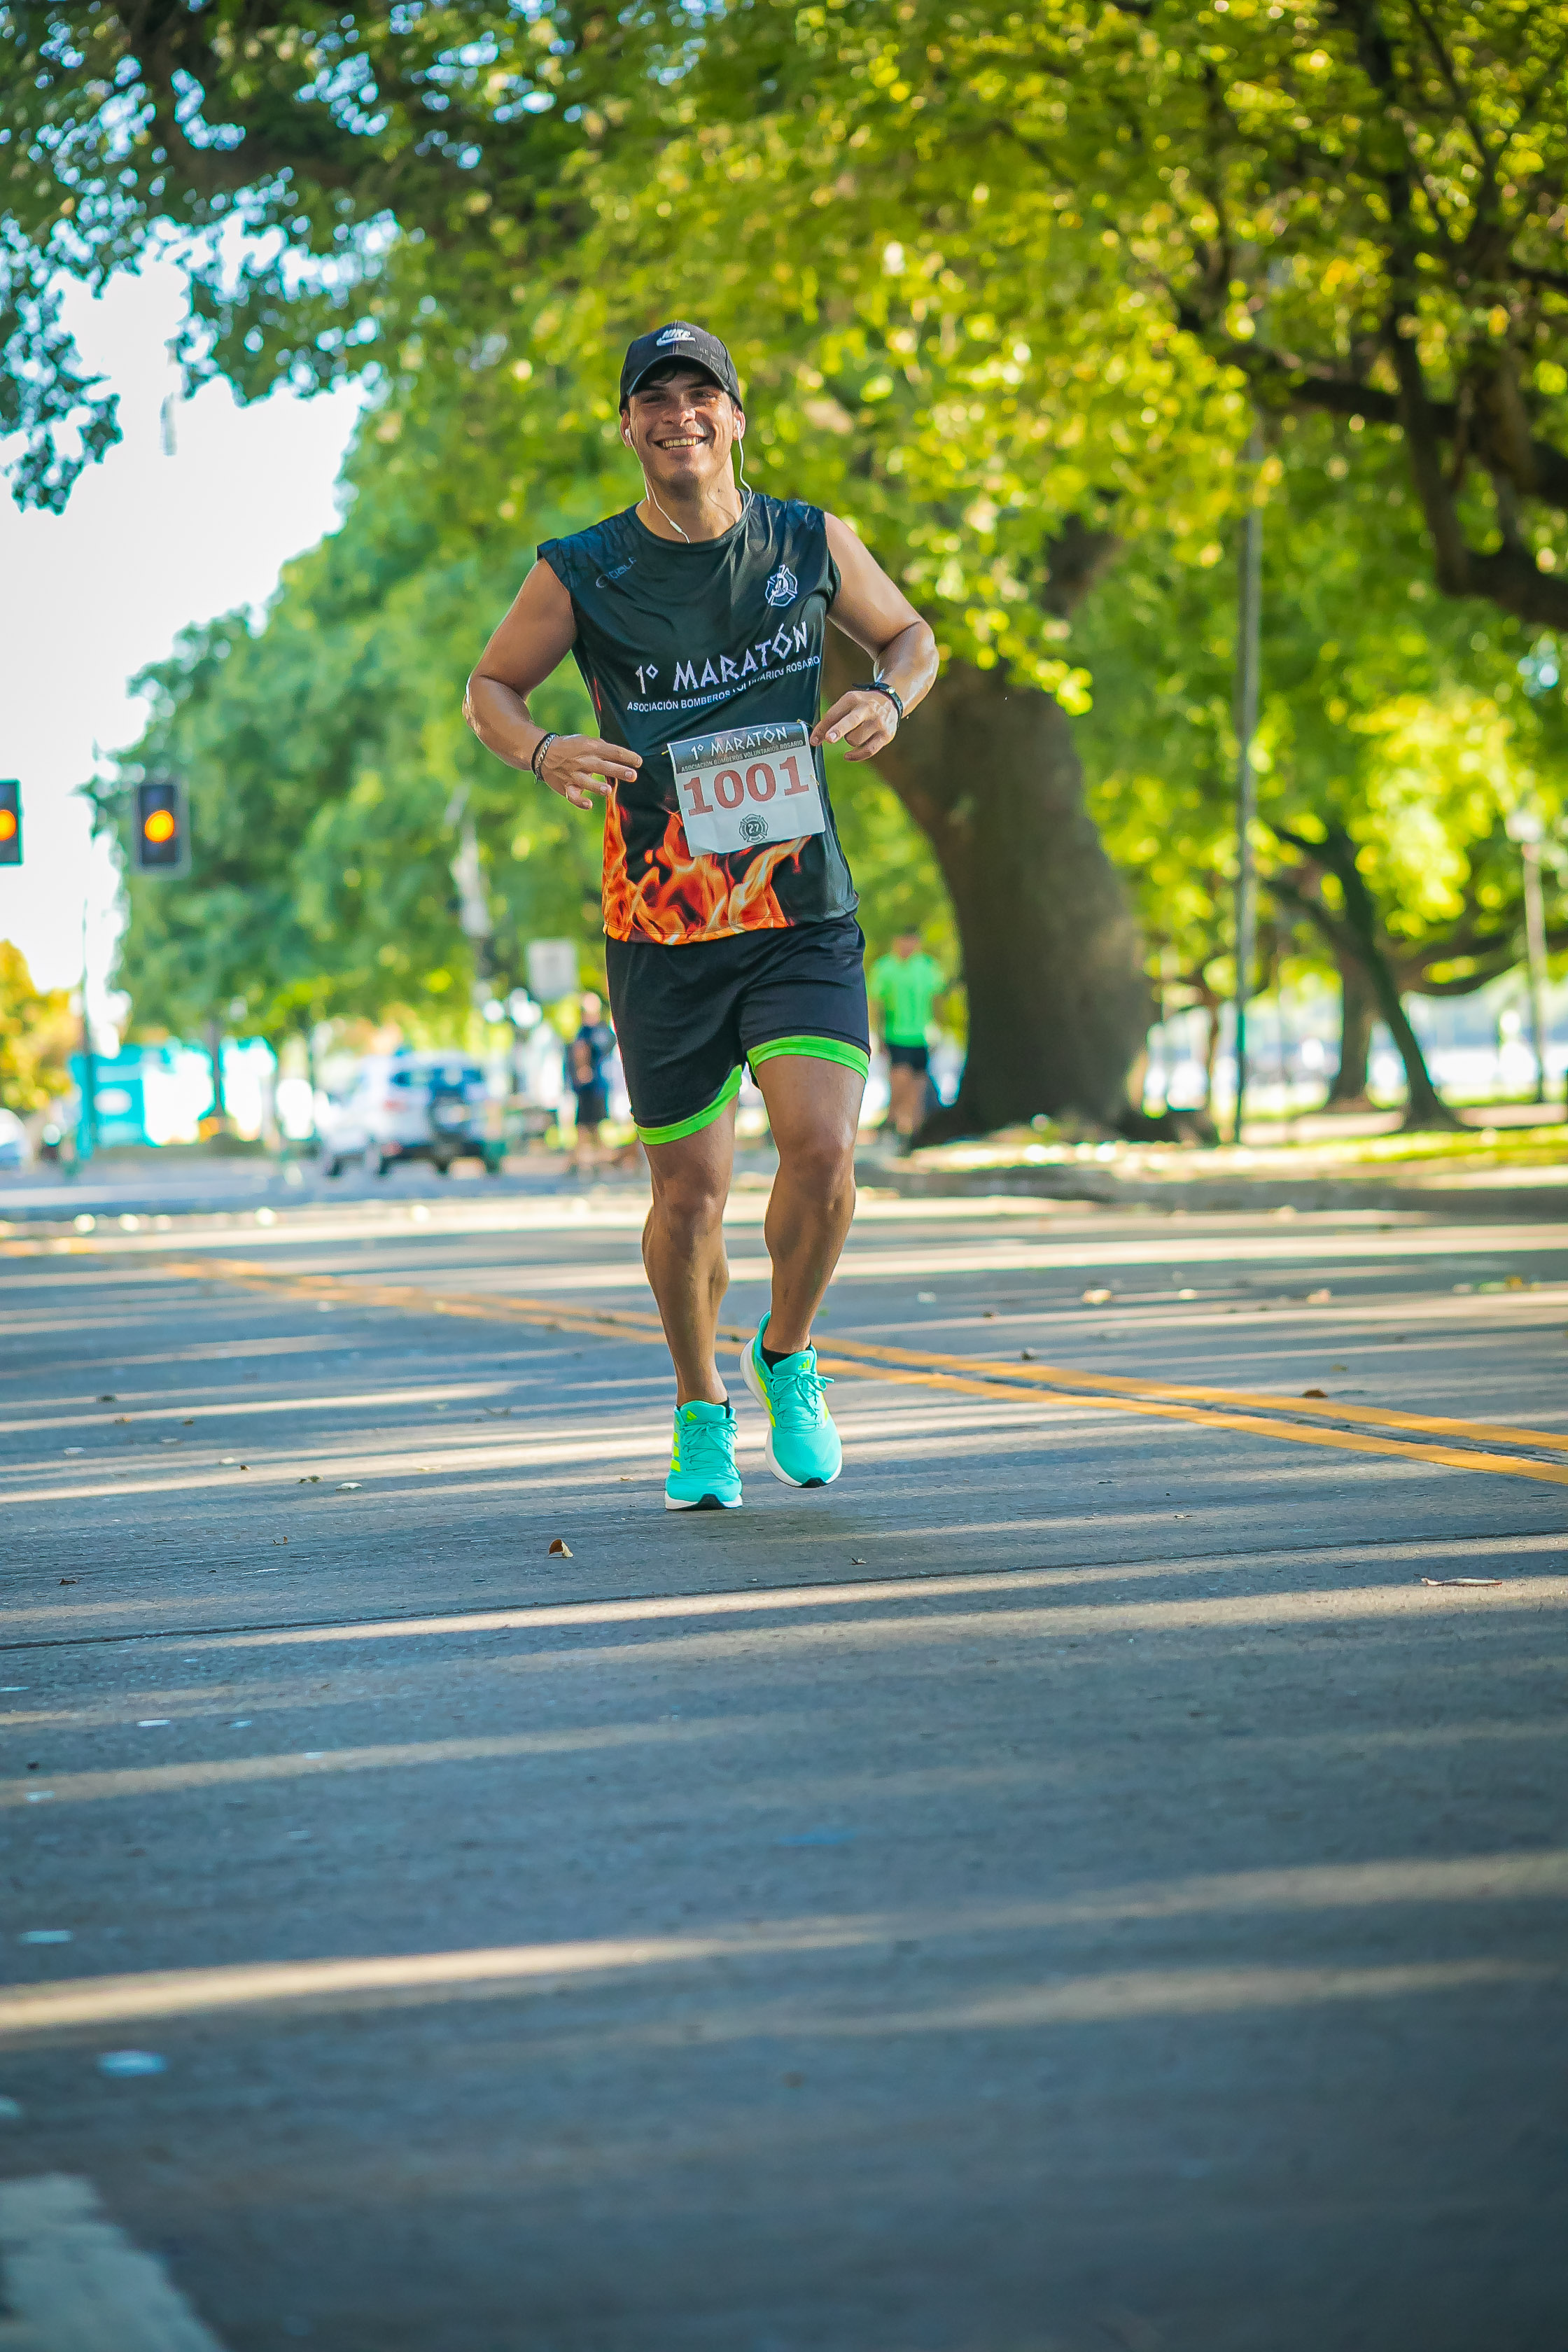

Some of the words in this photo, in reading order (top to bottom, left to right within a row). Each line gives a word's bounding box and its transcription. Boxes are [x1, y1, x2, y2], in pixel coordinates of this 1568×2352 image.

[662, 328, 691, 339] NIKE
[673, 620, 808, 692] MARATÓN
[626, 699, 679, 712] ASOCIACIÓN
[681, 690, 731, 709] BOMBEROS
[786, 656, 820, 673] ROSARIO
[710, 725, 788, 756] MARATÓN
[743, 746, 779, 758] VOLUNTARIOS
[780, 739, 804, 750] ROSARIO
[683, 755, 810, 817] 1001
[748, 823, 760, 834] 27
